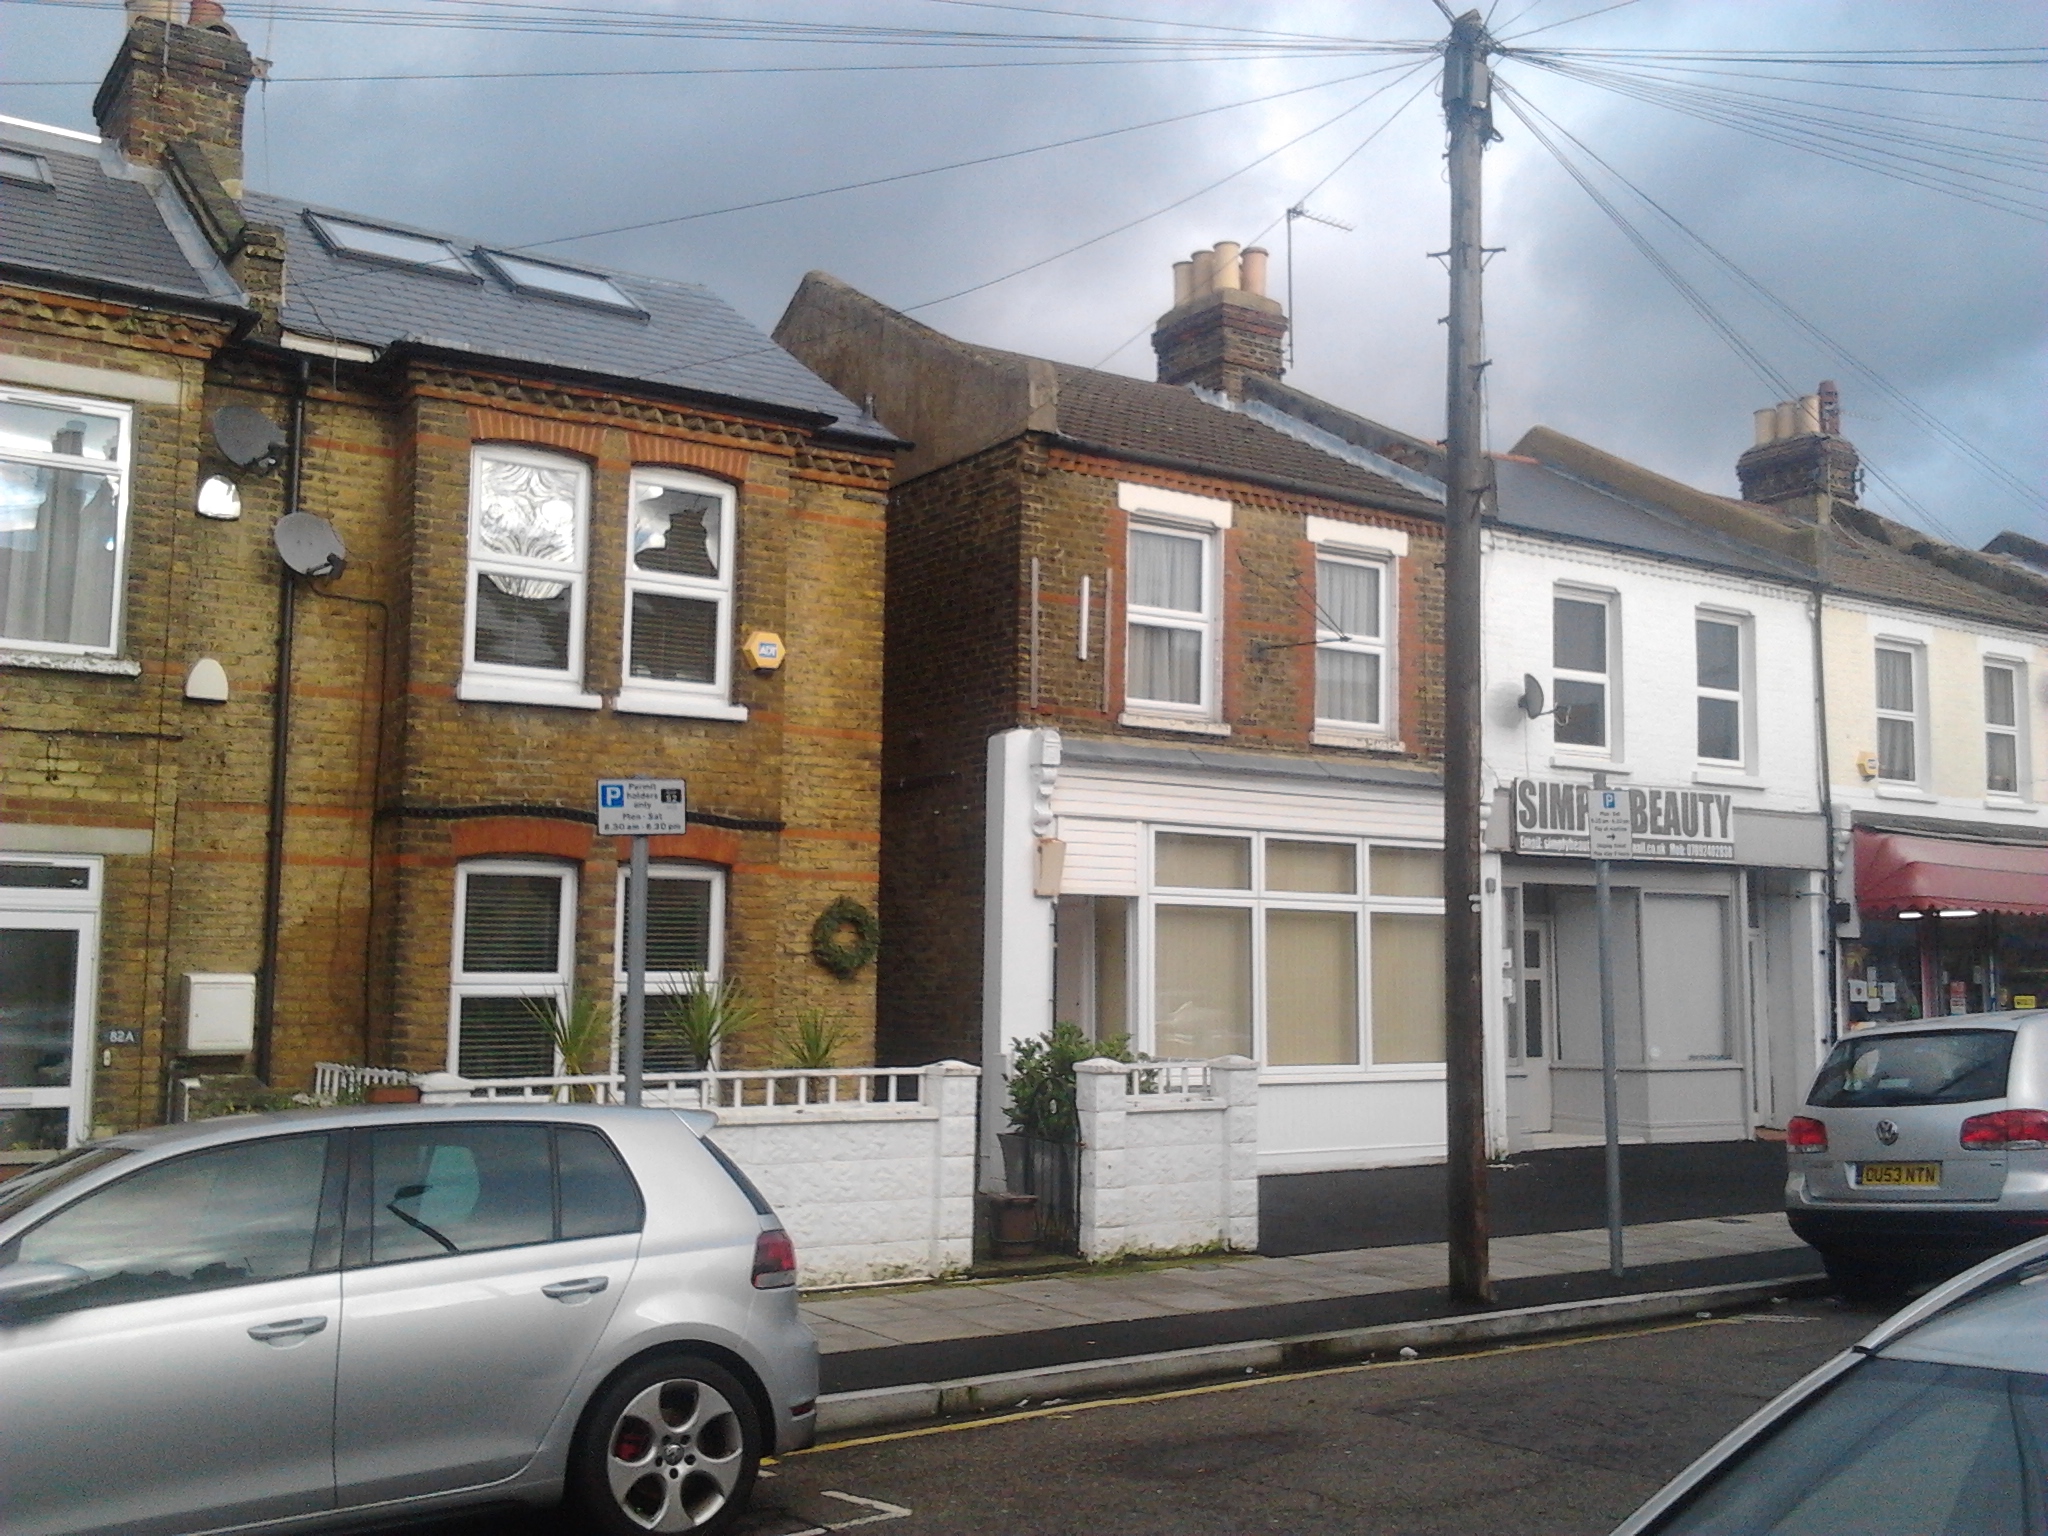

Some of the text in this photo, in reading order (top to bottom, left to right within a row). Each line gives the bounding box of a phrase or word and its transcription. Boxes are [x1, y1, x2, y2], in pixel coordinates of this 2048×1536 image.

[1518, 780, 1732, 838] SIMP BEAUTY
[1906, 1166, 1935, 1182] NTN
